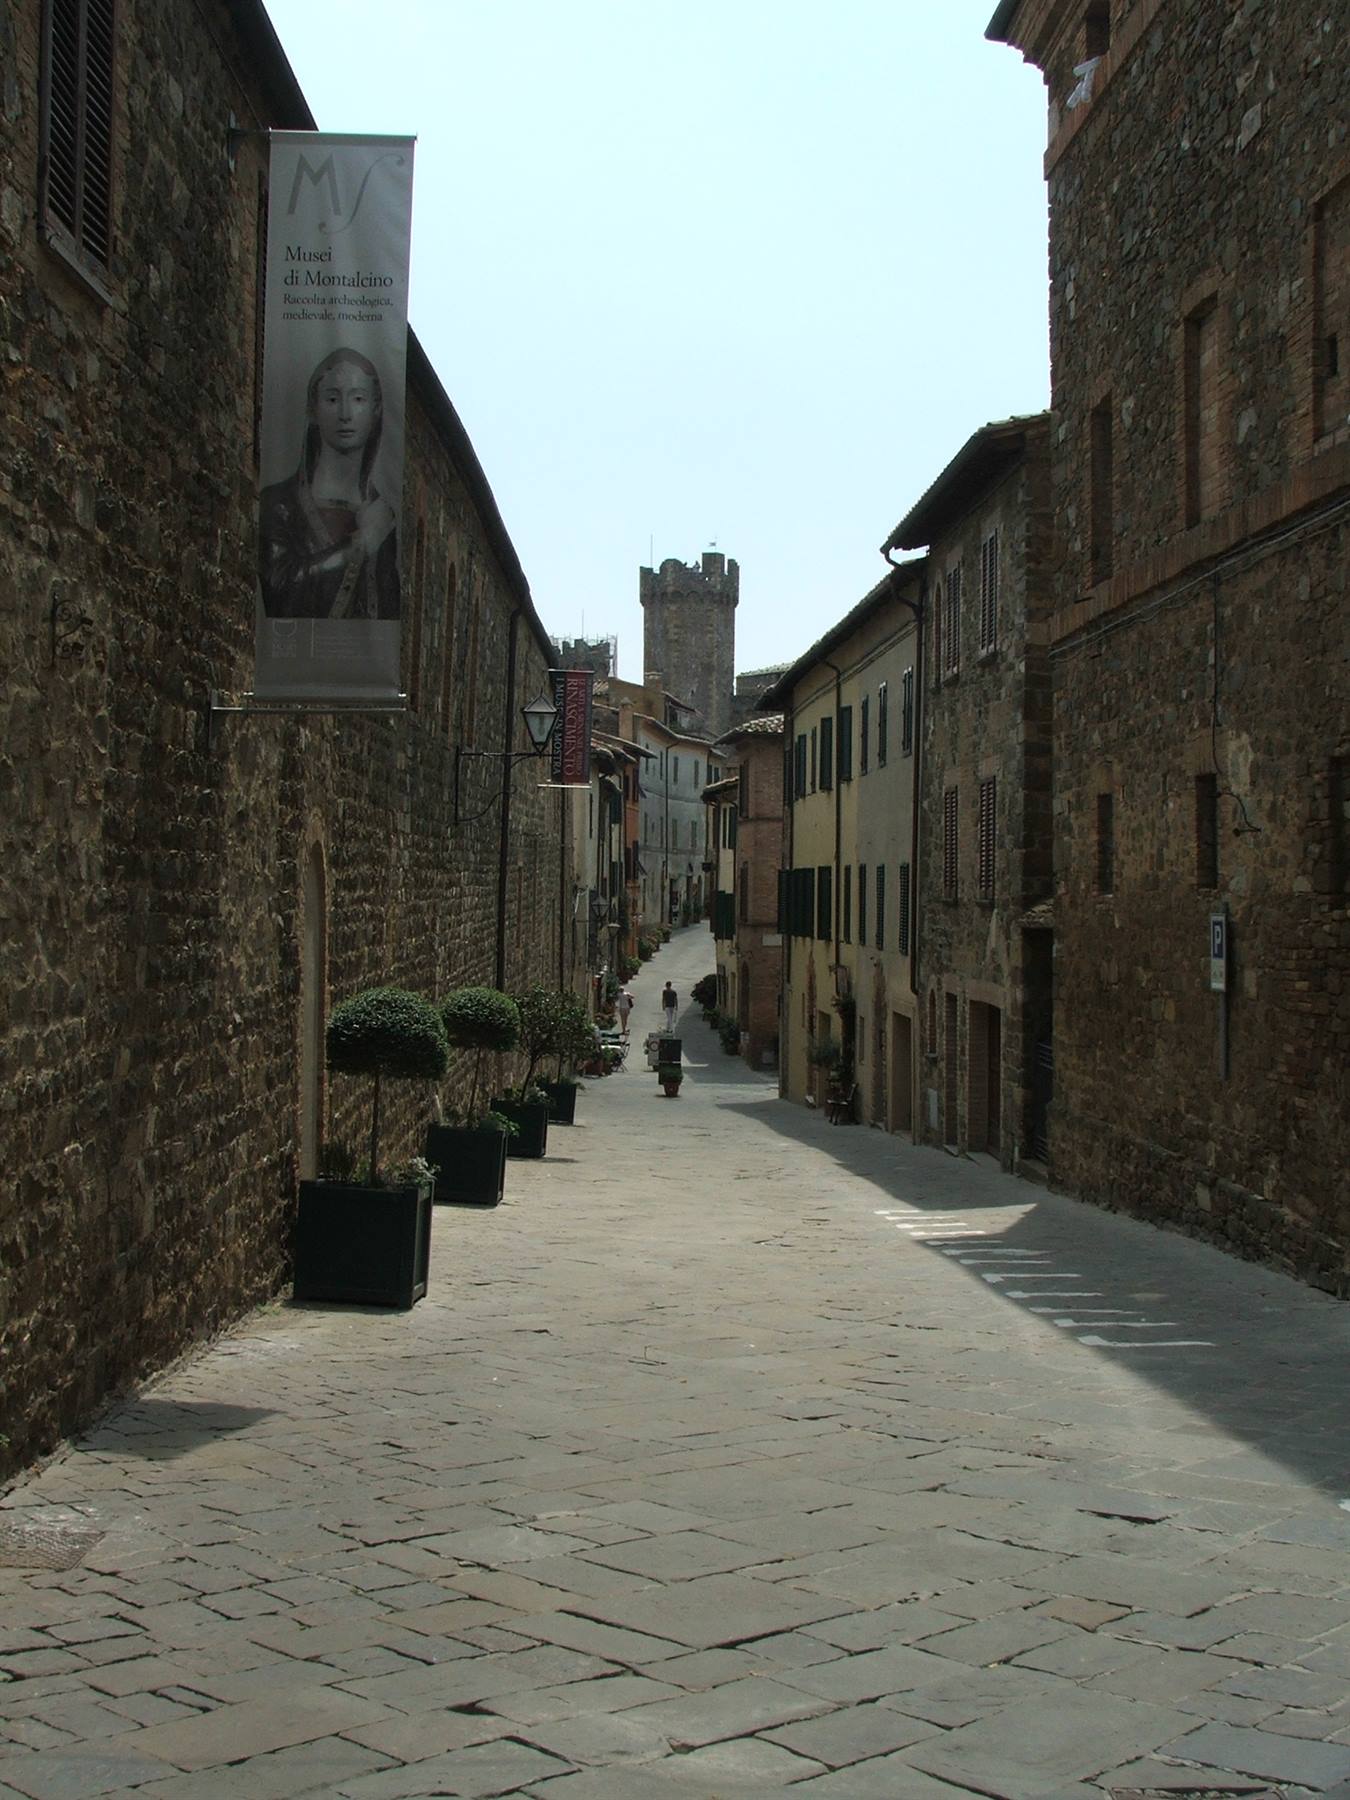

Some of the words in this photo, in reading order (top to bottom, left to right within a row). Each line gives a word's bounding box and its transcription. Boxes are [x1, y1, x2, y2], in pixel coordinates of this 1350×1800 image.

[285, 246, 333, 262] Musei
[283, 269, 299, 287] di
[304, 270, 393, 288] Montalcino
[283, 293, 327, 306] Raccolta
[328, 294, 394, 308] archeologica,
[282, 309, 336, 321] medievale,
[338, 310, 384, 322] moderna
[563, 677, 579, 776] RINASCIMENTO
[552, 732, 563, 776] MOSTRA
[1213, 925, 1222, 954] P
